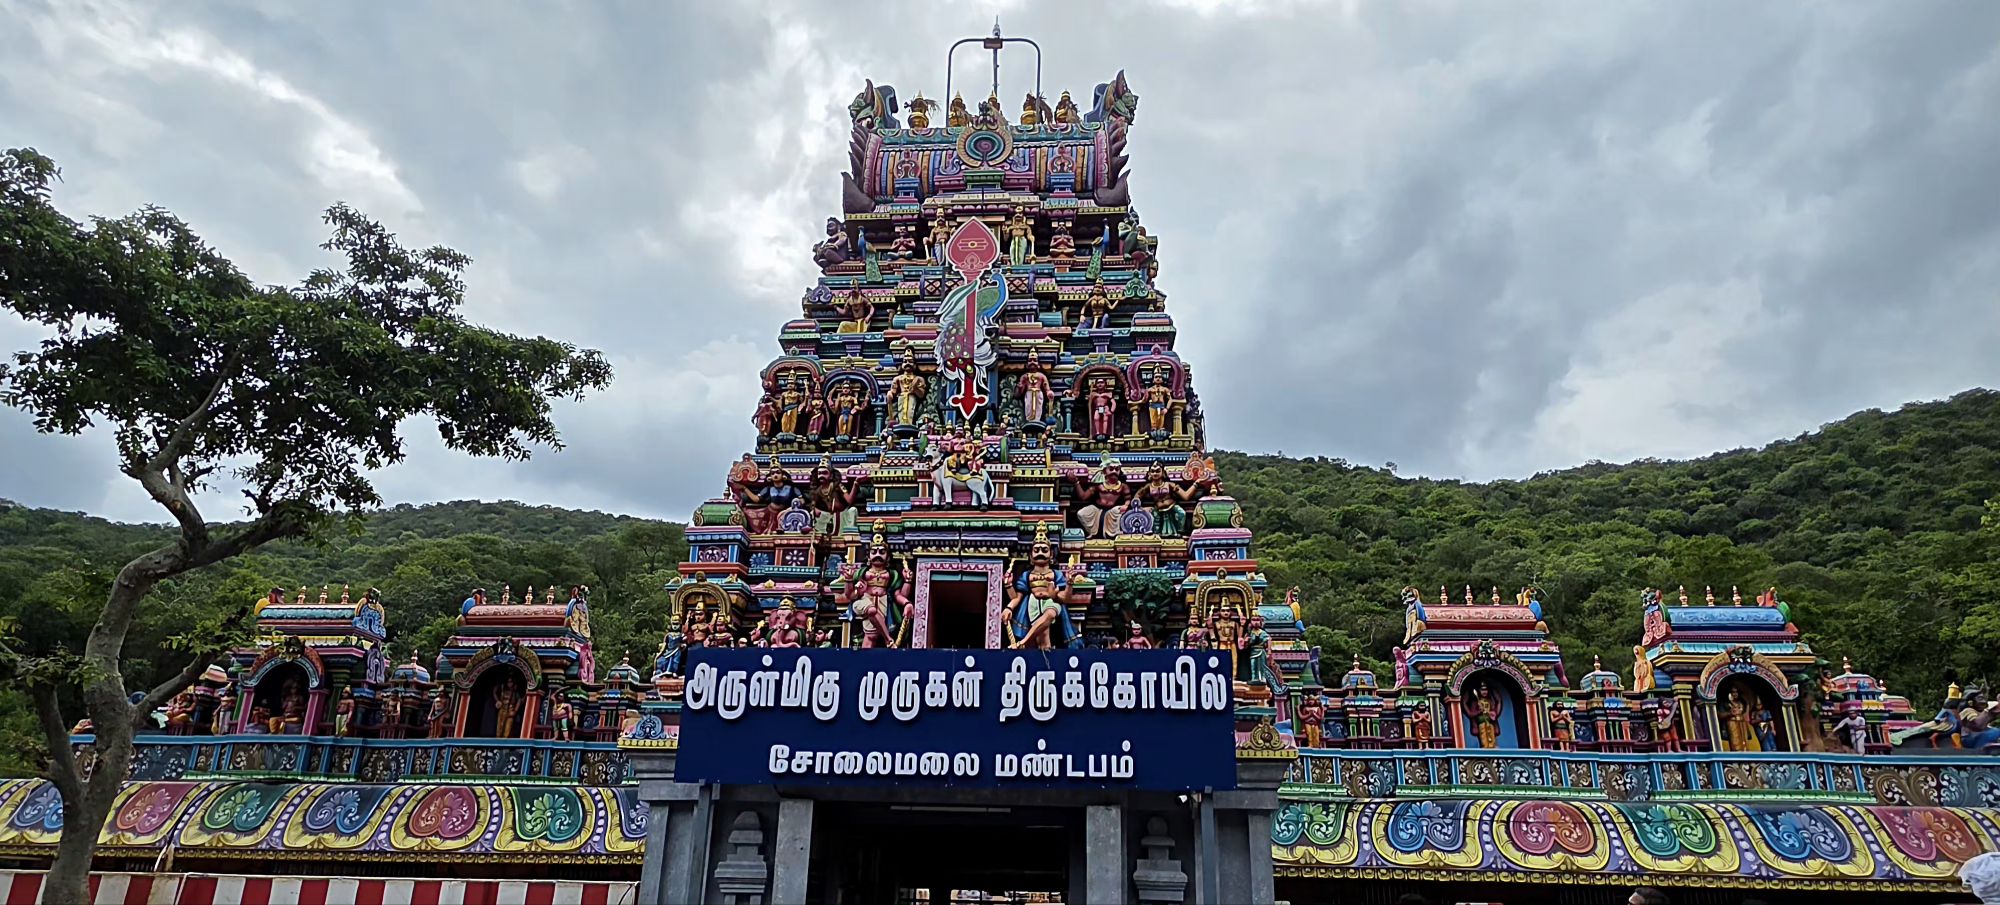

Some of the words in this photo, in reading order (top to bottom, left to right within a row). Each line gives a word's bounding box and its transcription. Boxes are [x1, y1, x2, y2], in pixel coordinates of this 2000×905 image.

[685, 655, 841, 720] அருள்மிகு
[858, 655, 982, 720] முருகன்
[1000, 655, 1226, 721] திருக்கோயில்
[768, 744, 980, 775] சோலைமலை
[995, 738, 1133, 777] மண்டபம்
